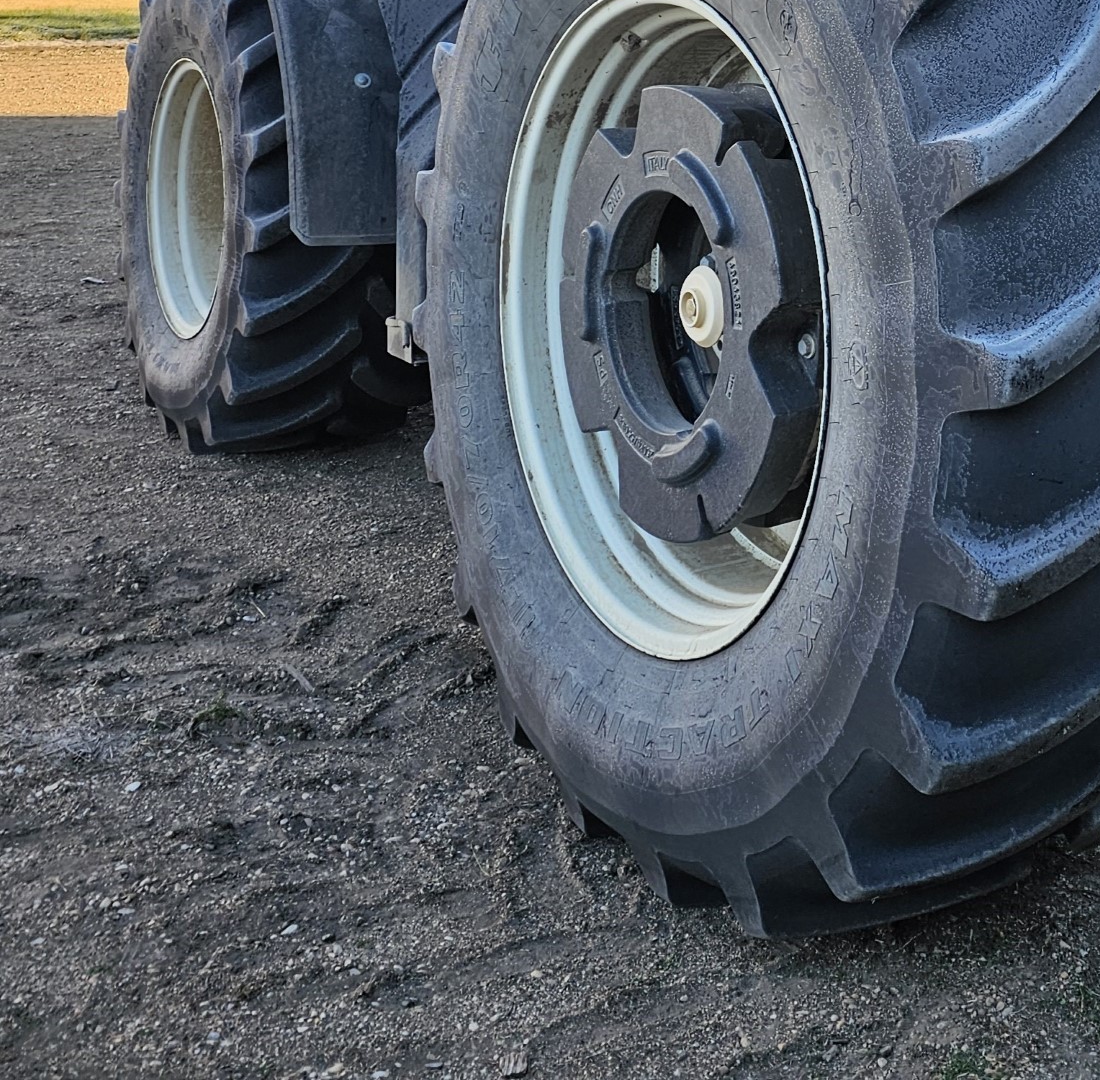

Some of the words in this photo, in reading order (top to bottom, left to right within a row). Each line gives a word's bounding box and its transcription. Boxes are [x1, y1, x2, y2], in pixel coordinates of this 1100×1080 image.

[648, 156, 669, 172] ITALY
[606, 185, 622, 215] CNH
[783, 486, 857, 684] MAXI
[555, 667, 773, 760] TRACTION
